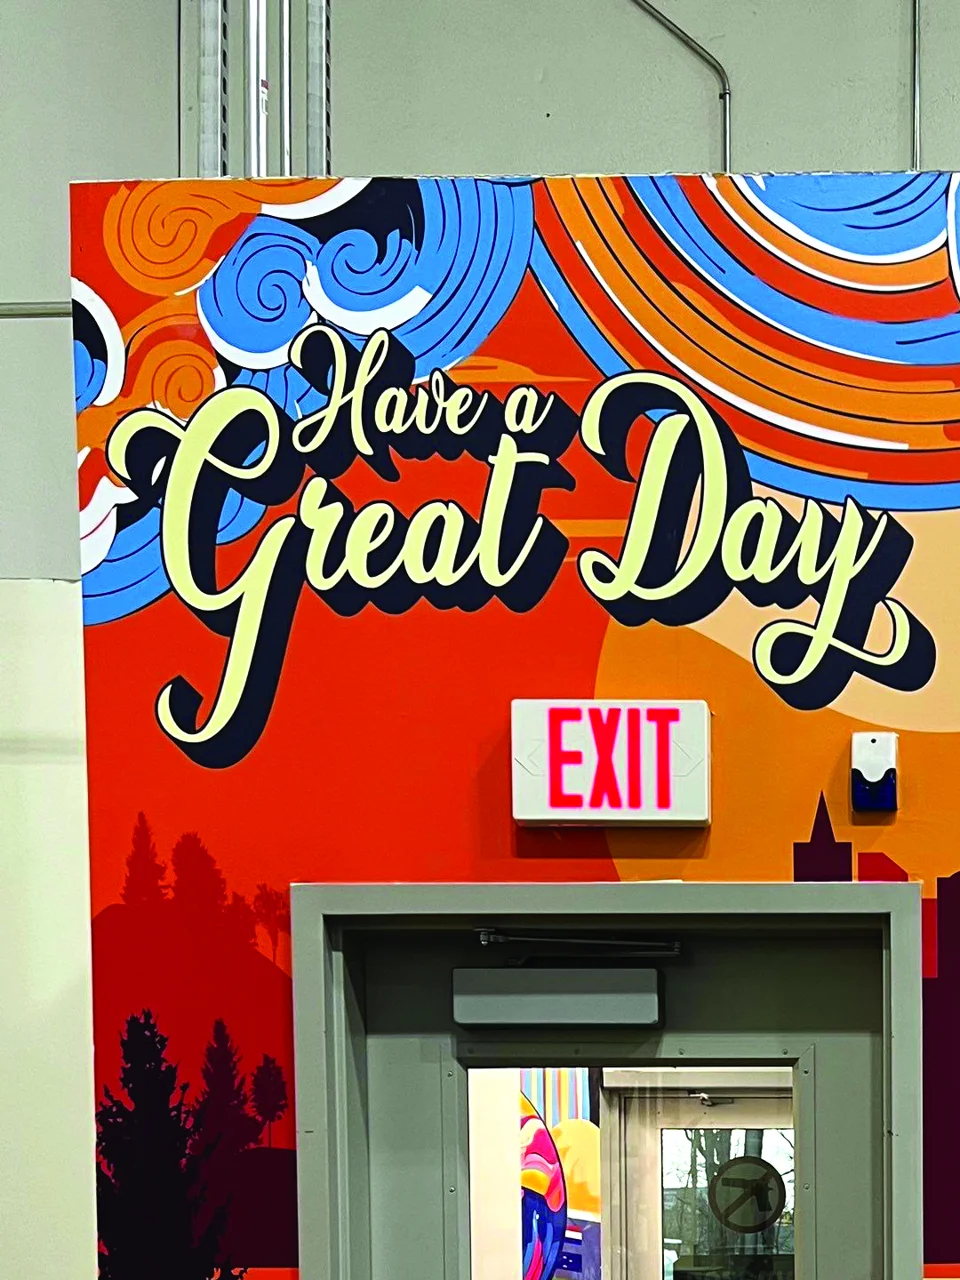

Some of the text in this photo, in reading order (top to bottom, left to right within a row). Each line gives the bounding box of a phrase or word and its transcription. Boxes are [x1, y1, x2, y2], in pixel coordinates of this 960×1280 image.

[289, 325, 556, 456] Have a
[106, 370, 912, 746] Great Day
[547, 707, 681, 810] EXIT
